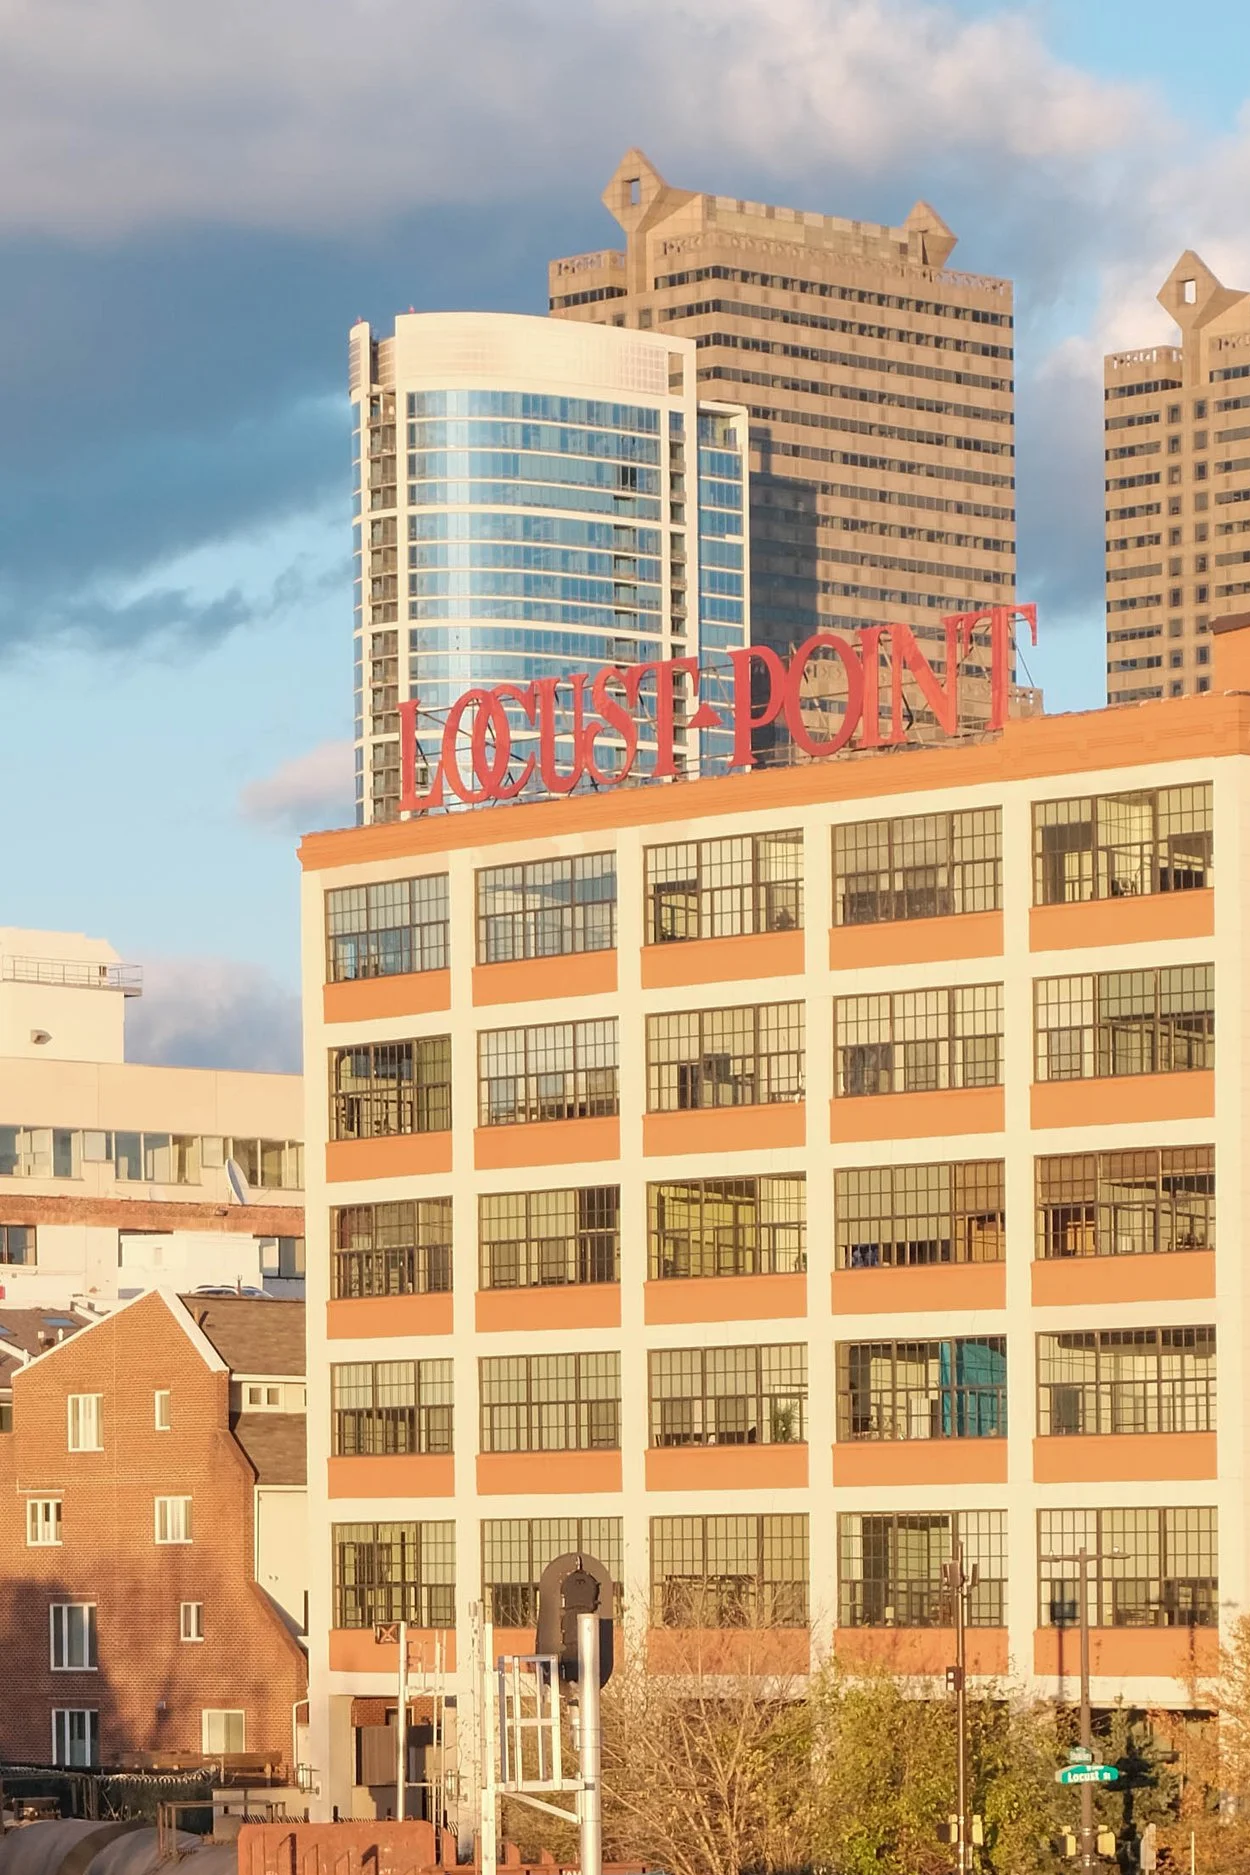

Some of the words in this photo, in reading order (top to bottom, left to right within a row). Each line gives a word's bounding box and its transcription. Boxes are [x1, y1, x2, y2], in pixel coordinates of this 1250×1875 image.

[397, 656, 699, 811] LOCUST
[727, 603, 1038, 767] POINT
[1067, 1772, 1100, 1783] Locust
